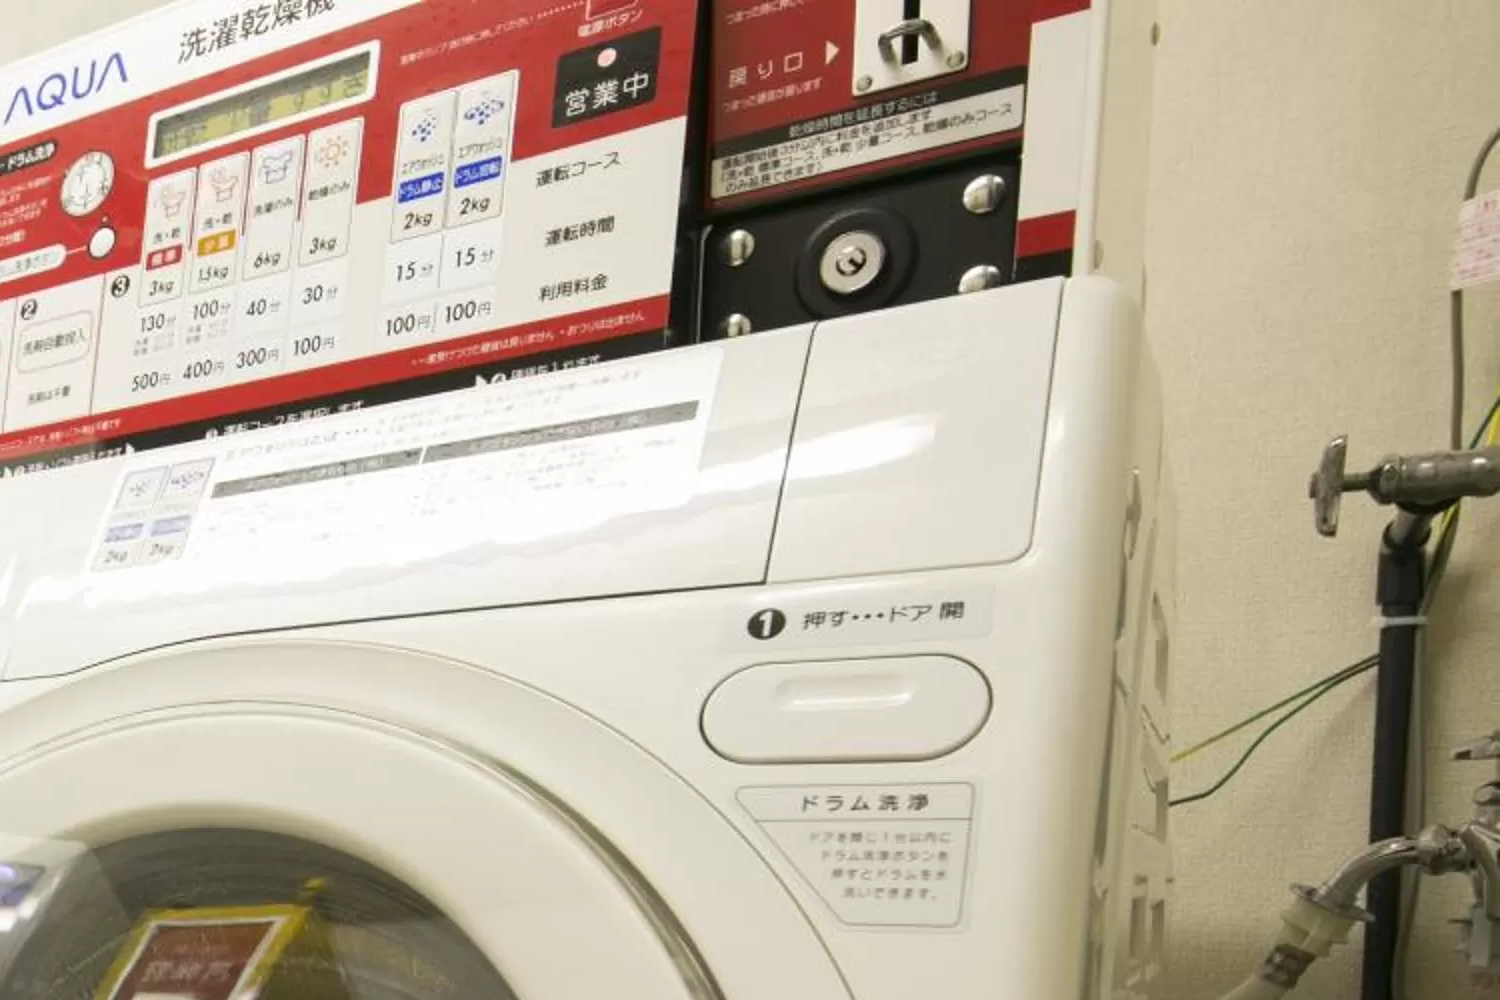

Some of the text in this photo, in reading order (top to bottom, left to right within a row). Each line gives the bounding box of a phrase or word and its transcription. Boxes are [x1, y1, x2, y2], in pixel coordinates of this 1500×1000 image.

[728, 51, 804, 89] 戻り口
[3, 52, 129, 125] AQUA
[565, 71, 650, 117] 営業中
[536, 151, 621, 188] 運転コース
[460, 197, 490, 216] 2kg
[404, 213, 433, 232] 2kg
[544, 215, 616, 248] 運転時間
[309, 236, 338, 255] 3kg
[253, 252, 281, 269] 6kg
[149, 280, 175, 297] 3kg
[539, 273, 609, 302] 利用料金
[800, 792, 930, 812] ドラム洗浄
